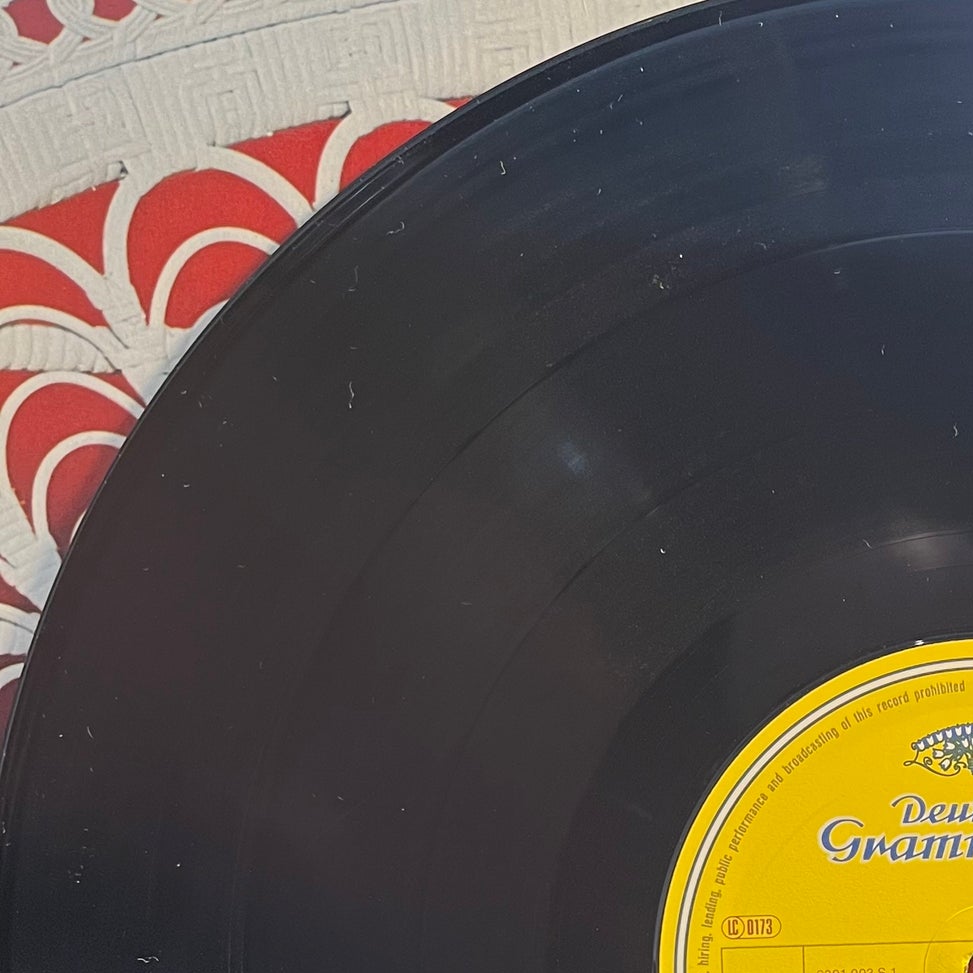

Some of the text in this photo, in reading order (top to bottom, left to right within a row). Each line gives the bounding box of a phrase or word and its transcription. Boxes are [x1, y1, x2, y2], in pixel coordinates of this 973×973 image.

[715, 855, 732, 885] public
[729, 793, 768, 852] performance
[768, 772, 783, 792] and
[782, 728, 839, 774] broadcasting
[841, 717, 851, 730] of
[853, 708, 873, 722] this
[877, 691, 909, 712] record
[914, 680, 965, 702] prohibited
[728, 919, 772, 935] LC 0173
